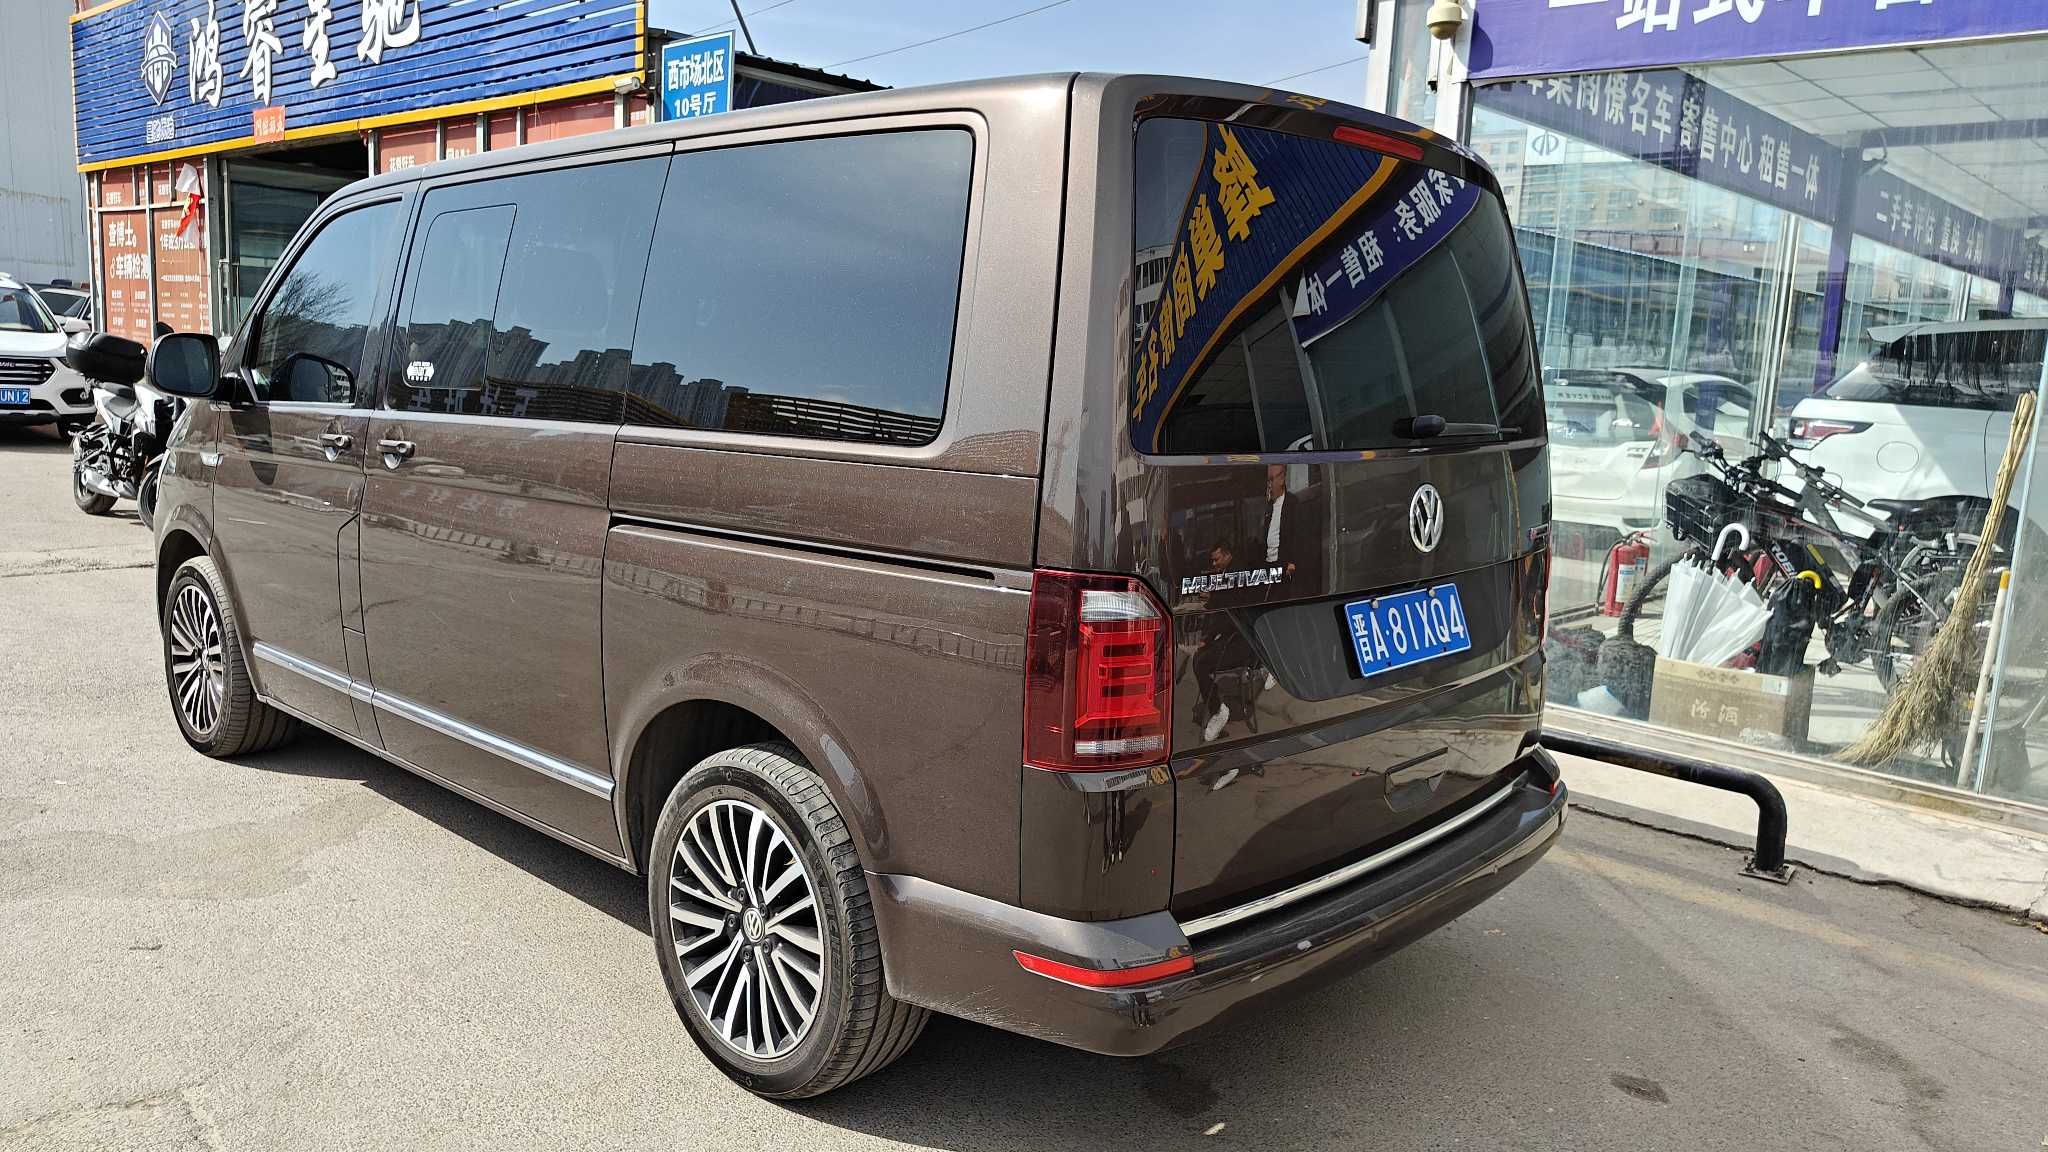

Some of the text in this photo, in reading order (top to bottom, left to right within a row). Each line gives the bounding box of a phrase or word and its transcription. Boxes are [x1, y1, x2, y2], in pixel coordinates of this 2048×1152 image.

[668, 49, 725, 91] 西市场北区
[674, 91, 717, 118] 10号厅
[1181, 567, 1283, 594] MULTIVAN
